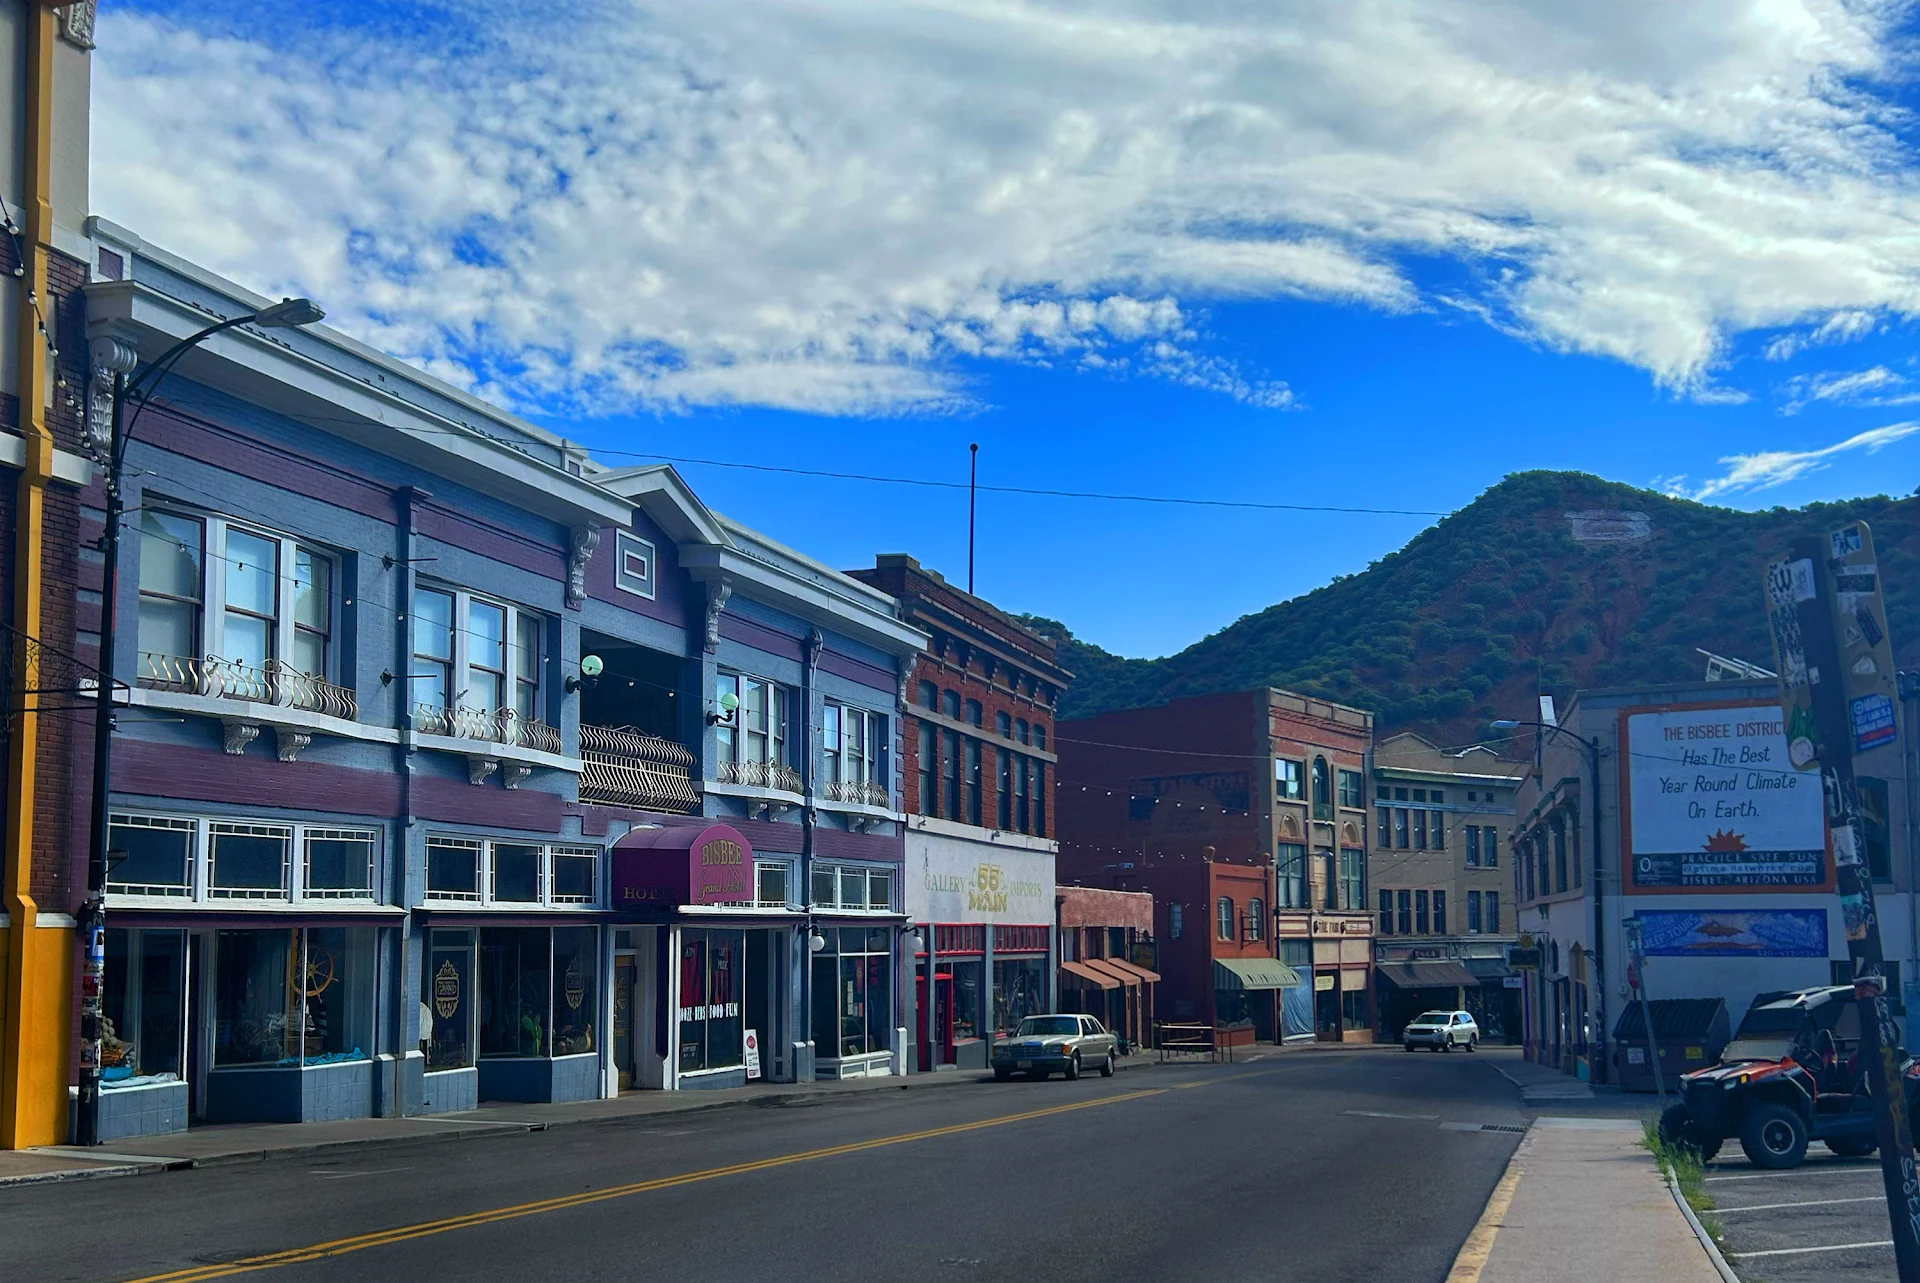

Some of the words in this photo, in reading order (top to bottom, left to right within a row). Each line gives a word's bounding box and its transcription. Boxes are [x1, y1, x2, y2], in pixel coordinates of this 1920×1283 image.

[1664, 727, 1684, 741] THE
[1688, 724, 1730, 740] BISBEE
[1712, 747, 1736, 765] The
[1740, 745, 1771, 764] Best
[1659, 776, 1689, 794] Year
[1694, 773, 1737, 793] Round
[1746, 772, 1797, 790] Climate
[1688, 801, 1706, 818] On
[701, 839, 743, 866] BISBEE
[1681, 853, 1741, 862] PRACTICE
[1751, 852, 1779, 862] SAFE
[1789, 852, 1818, 862] SUN
[697, 869, 723, 901] Grand
[924, 873, 966, 893] GALLERY
[1010, 881, 1042, 898] IMPORTS
[1735, 875, 1788, 885] ARIZONA
[1794, 874, 1817, 884] USA
[623, 886, 667, 900] HOT
[968, 890, 1008, 913] MAIN
[1643, 933, 1665, 949] JEEP
[1666, 914, 1698, 939] TOURS
[680, 1007, 692, 1022] OOZE
[726, 1003, 738, 1018] FUN
